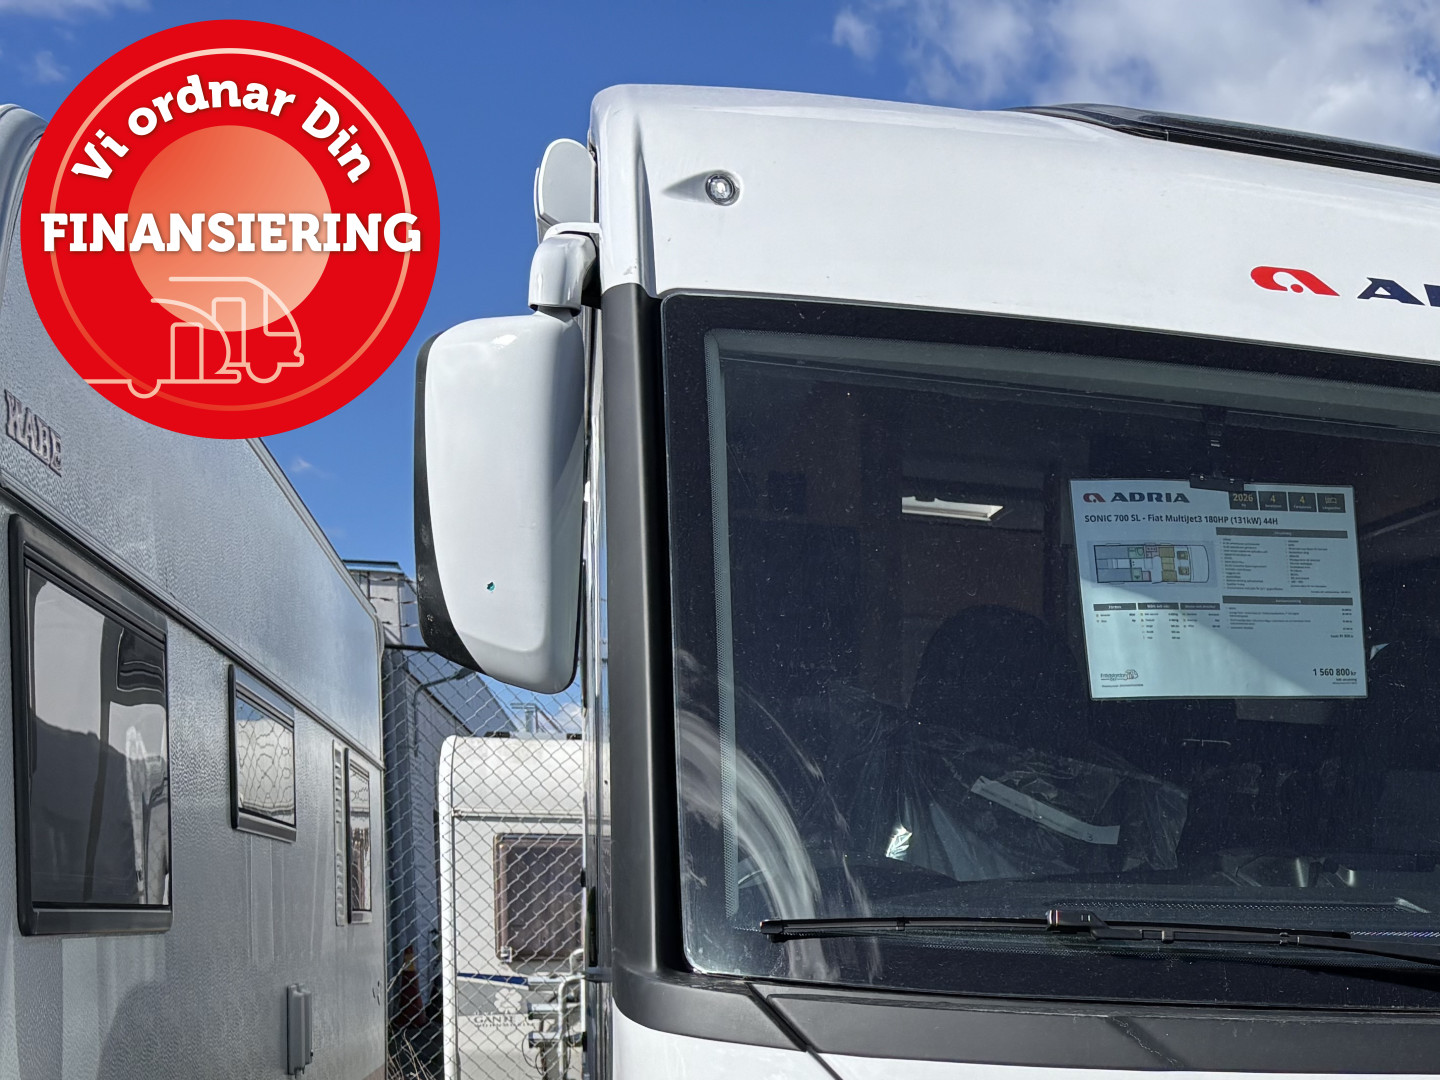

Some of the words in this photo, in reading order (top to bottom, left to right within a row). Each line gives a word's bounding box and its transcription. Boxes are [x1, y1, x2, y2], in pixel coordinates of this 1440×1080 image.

[1110, 492, 1191, 503] ADRIA
[1232, 493, 1254, 502] 2026
[1084, 514, 1112, 523] SONIC
[1114, 514, 1129, 522] 700
[1131, 514, 1141, 522] SL
[1147, 514, 1163, 522] Fiat
[1205, 515, 1229, 524] 180HP
[1230, 516, 1262, 526] (131kW)
[1263, 517, 1279, 525] 44H
[1312, 668, 1317, 676] 1
[1319, 668, 1334, 676] 560
[1335, 668, 1350, 676] 800
